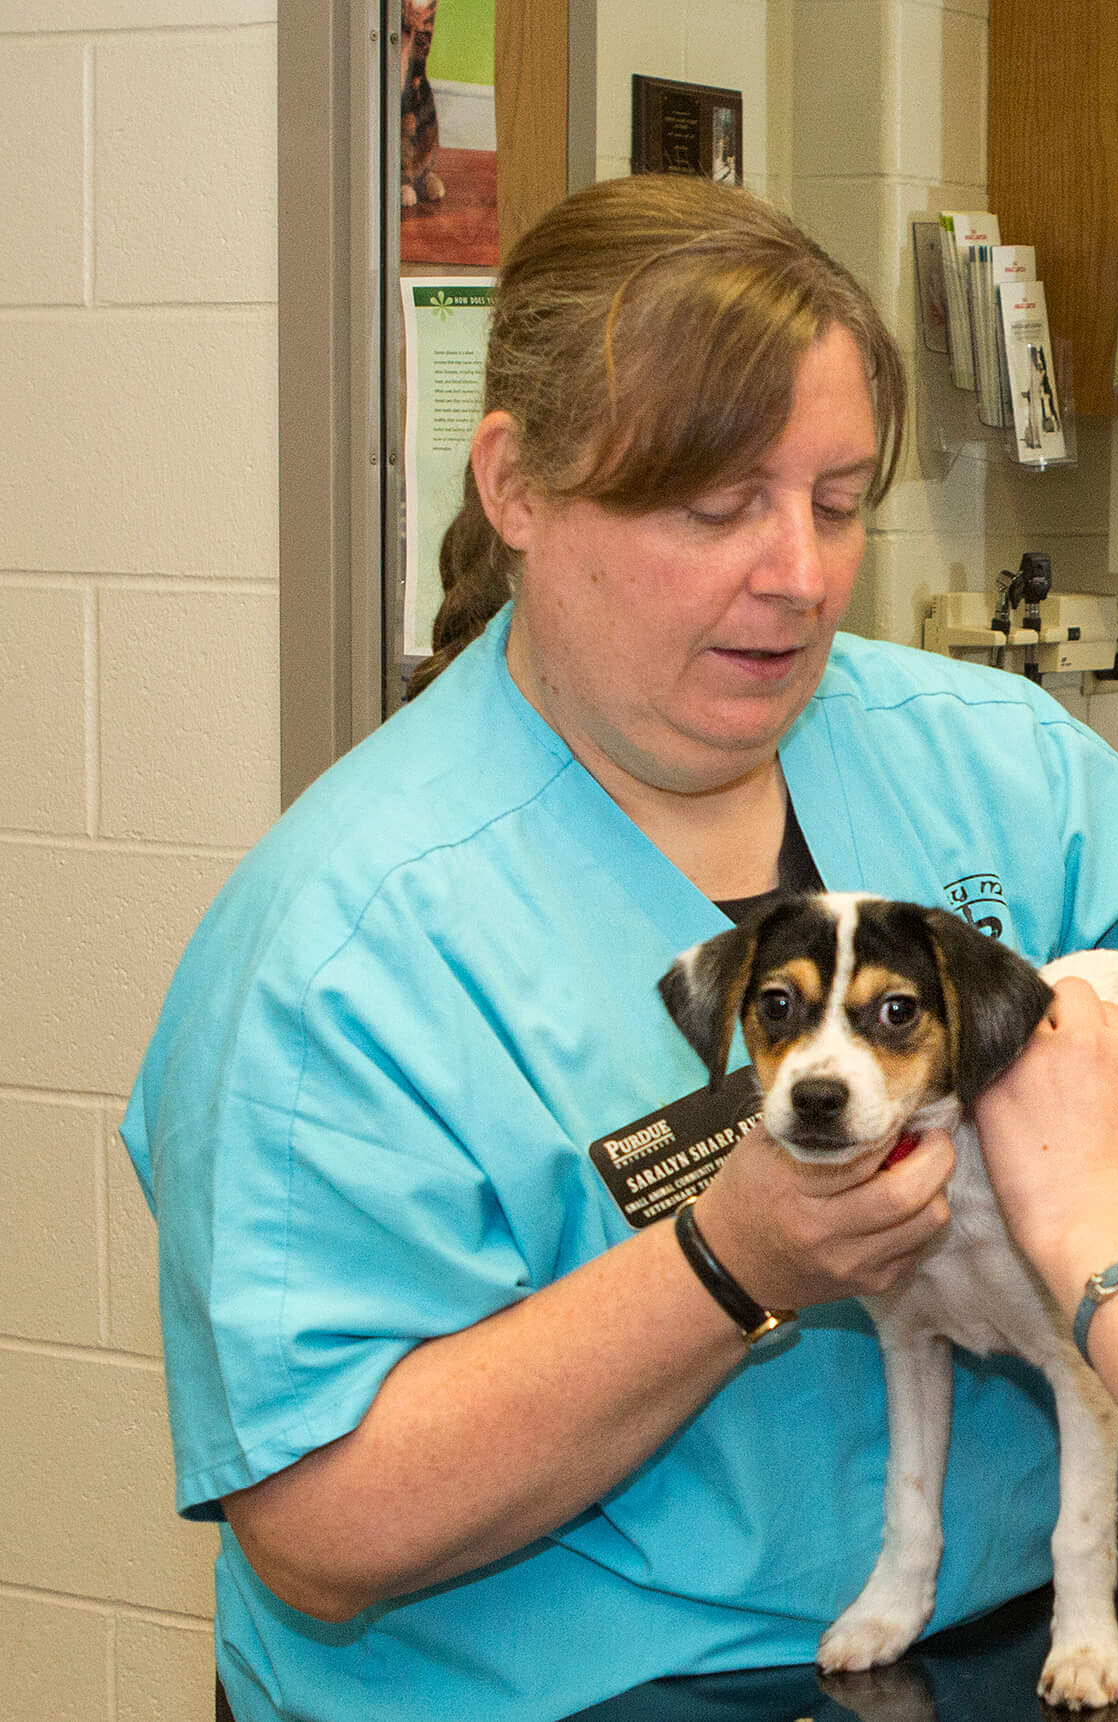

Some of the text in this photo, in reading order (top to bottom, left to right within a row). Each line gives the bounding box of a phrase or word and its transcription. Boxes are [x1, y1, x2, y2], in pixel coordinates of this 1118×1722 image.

[603, 1118, 672, 1160] PURDUE
[626, 1151, 690, 1193] SARALYN
[643, 1184, 697, 1218] VETERINARY
